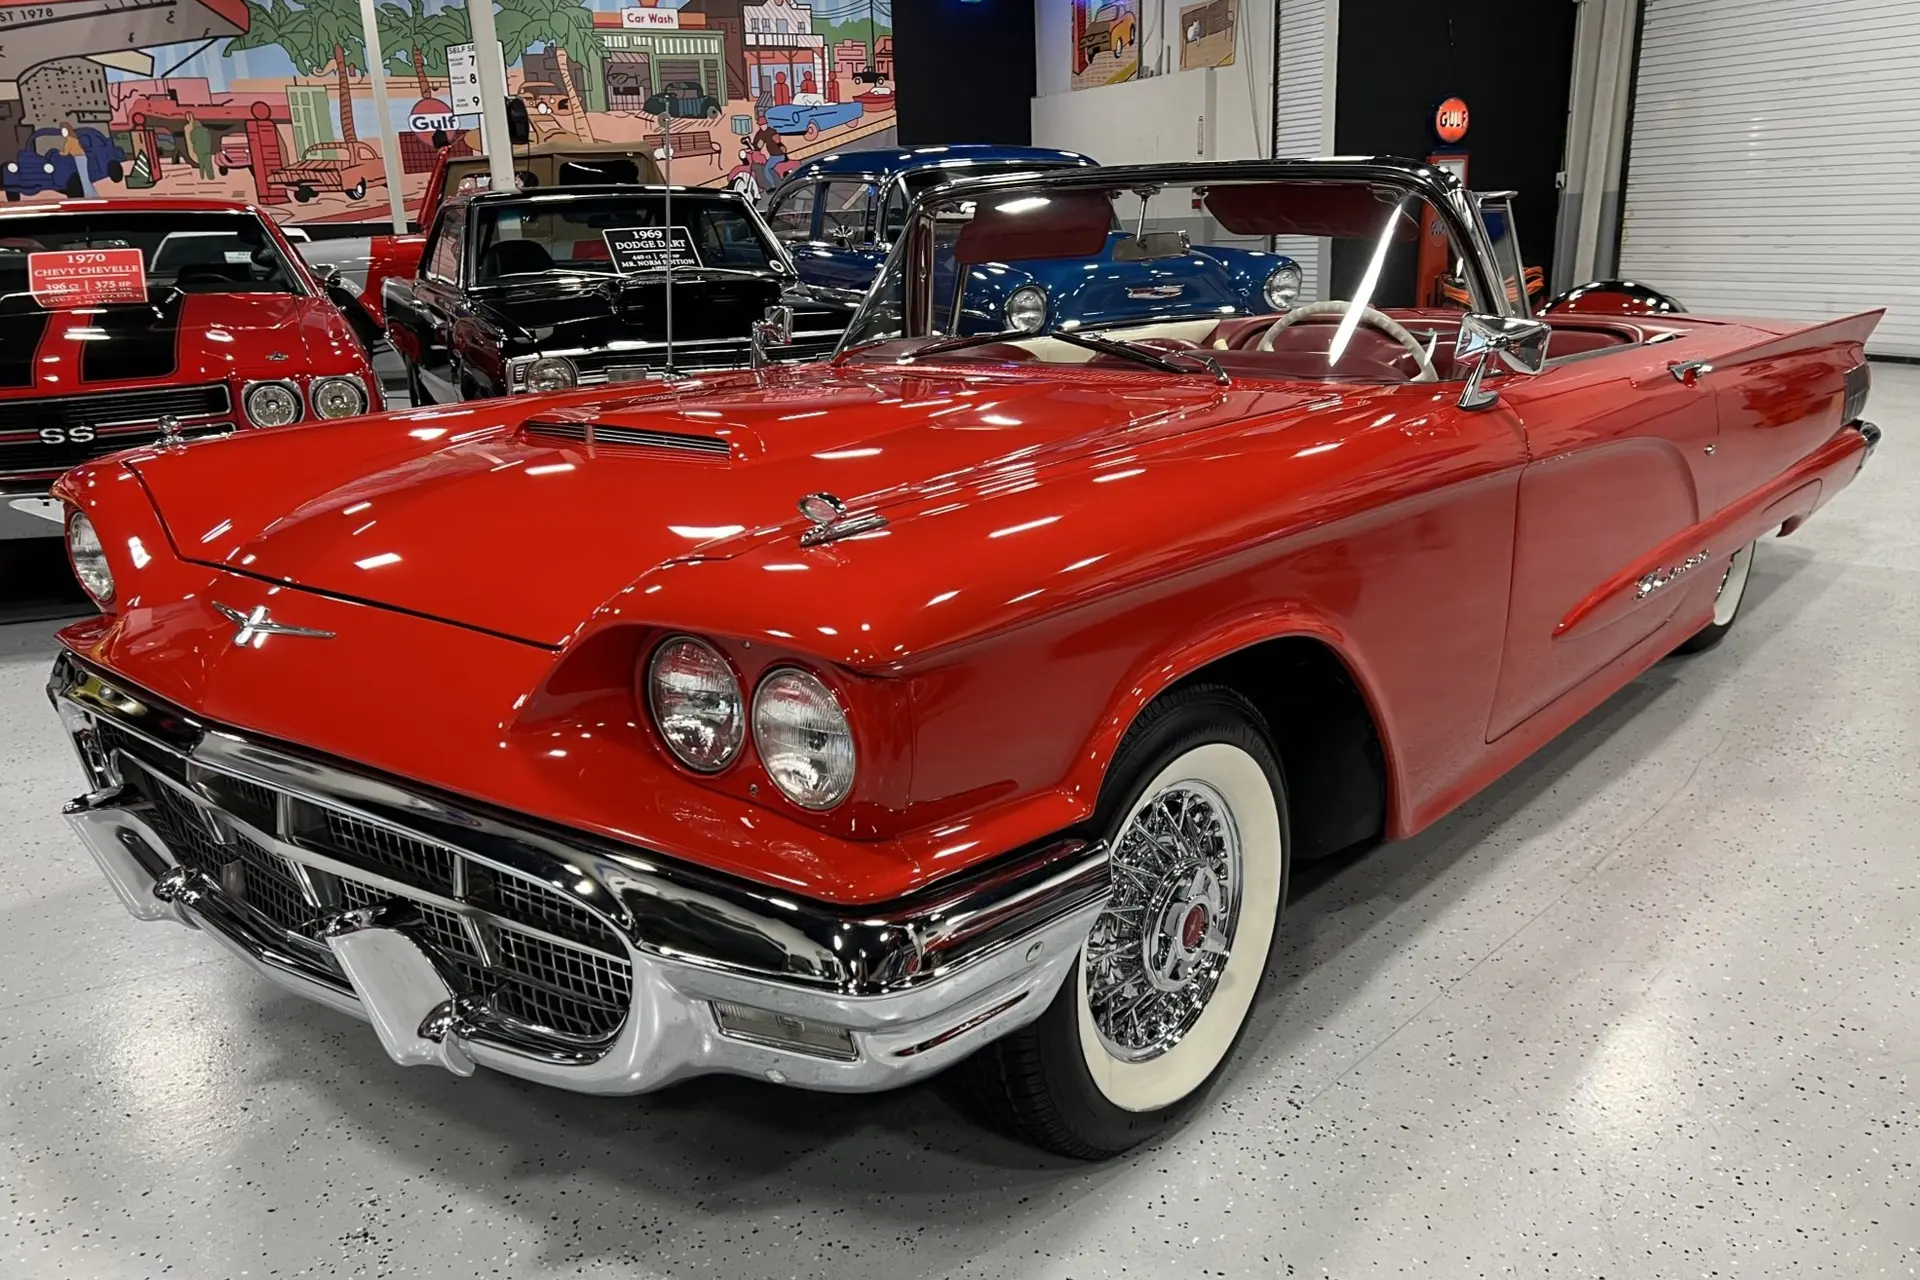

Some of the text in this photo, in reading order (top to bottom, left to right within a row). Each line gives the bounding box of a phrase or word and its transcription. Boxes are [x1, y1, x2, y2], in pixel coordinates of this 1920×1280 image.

[20, 7, 54, 20] 1978
[627, 13, 674, 24] Car Wash
[448, 45, 466, 54] SELF
[468, 55, 475, 66] 7
[469, 73, 477, 84] 8
[472, 96, 480, 107] 9
[412, 116, 456, 130] Gulf
[1440, 110, 1467, 128] GULF
[632, 229, 663, 240] 1969
[615, 240, 656, 250] DODGE
[67, 253, 106, 264] 1970
[34, 264, 140, 277] CHEVY CHEVELLE
[45, 282, 67, 291] 396
[95, 280, 116, 289] 375
[40, 425, 95, 444] SS
